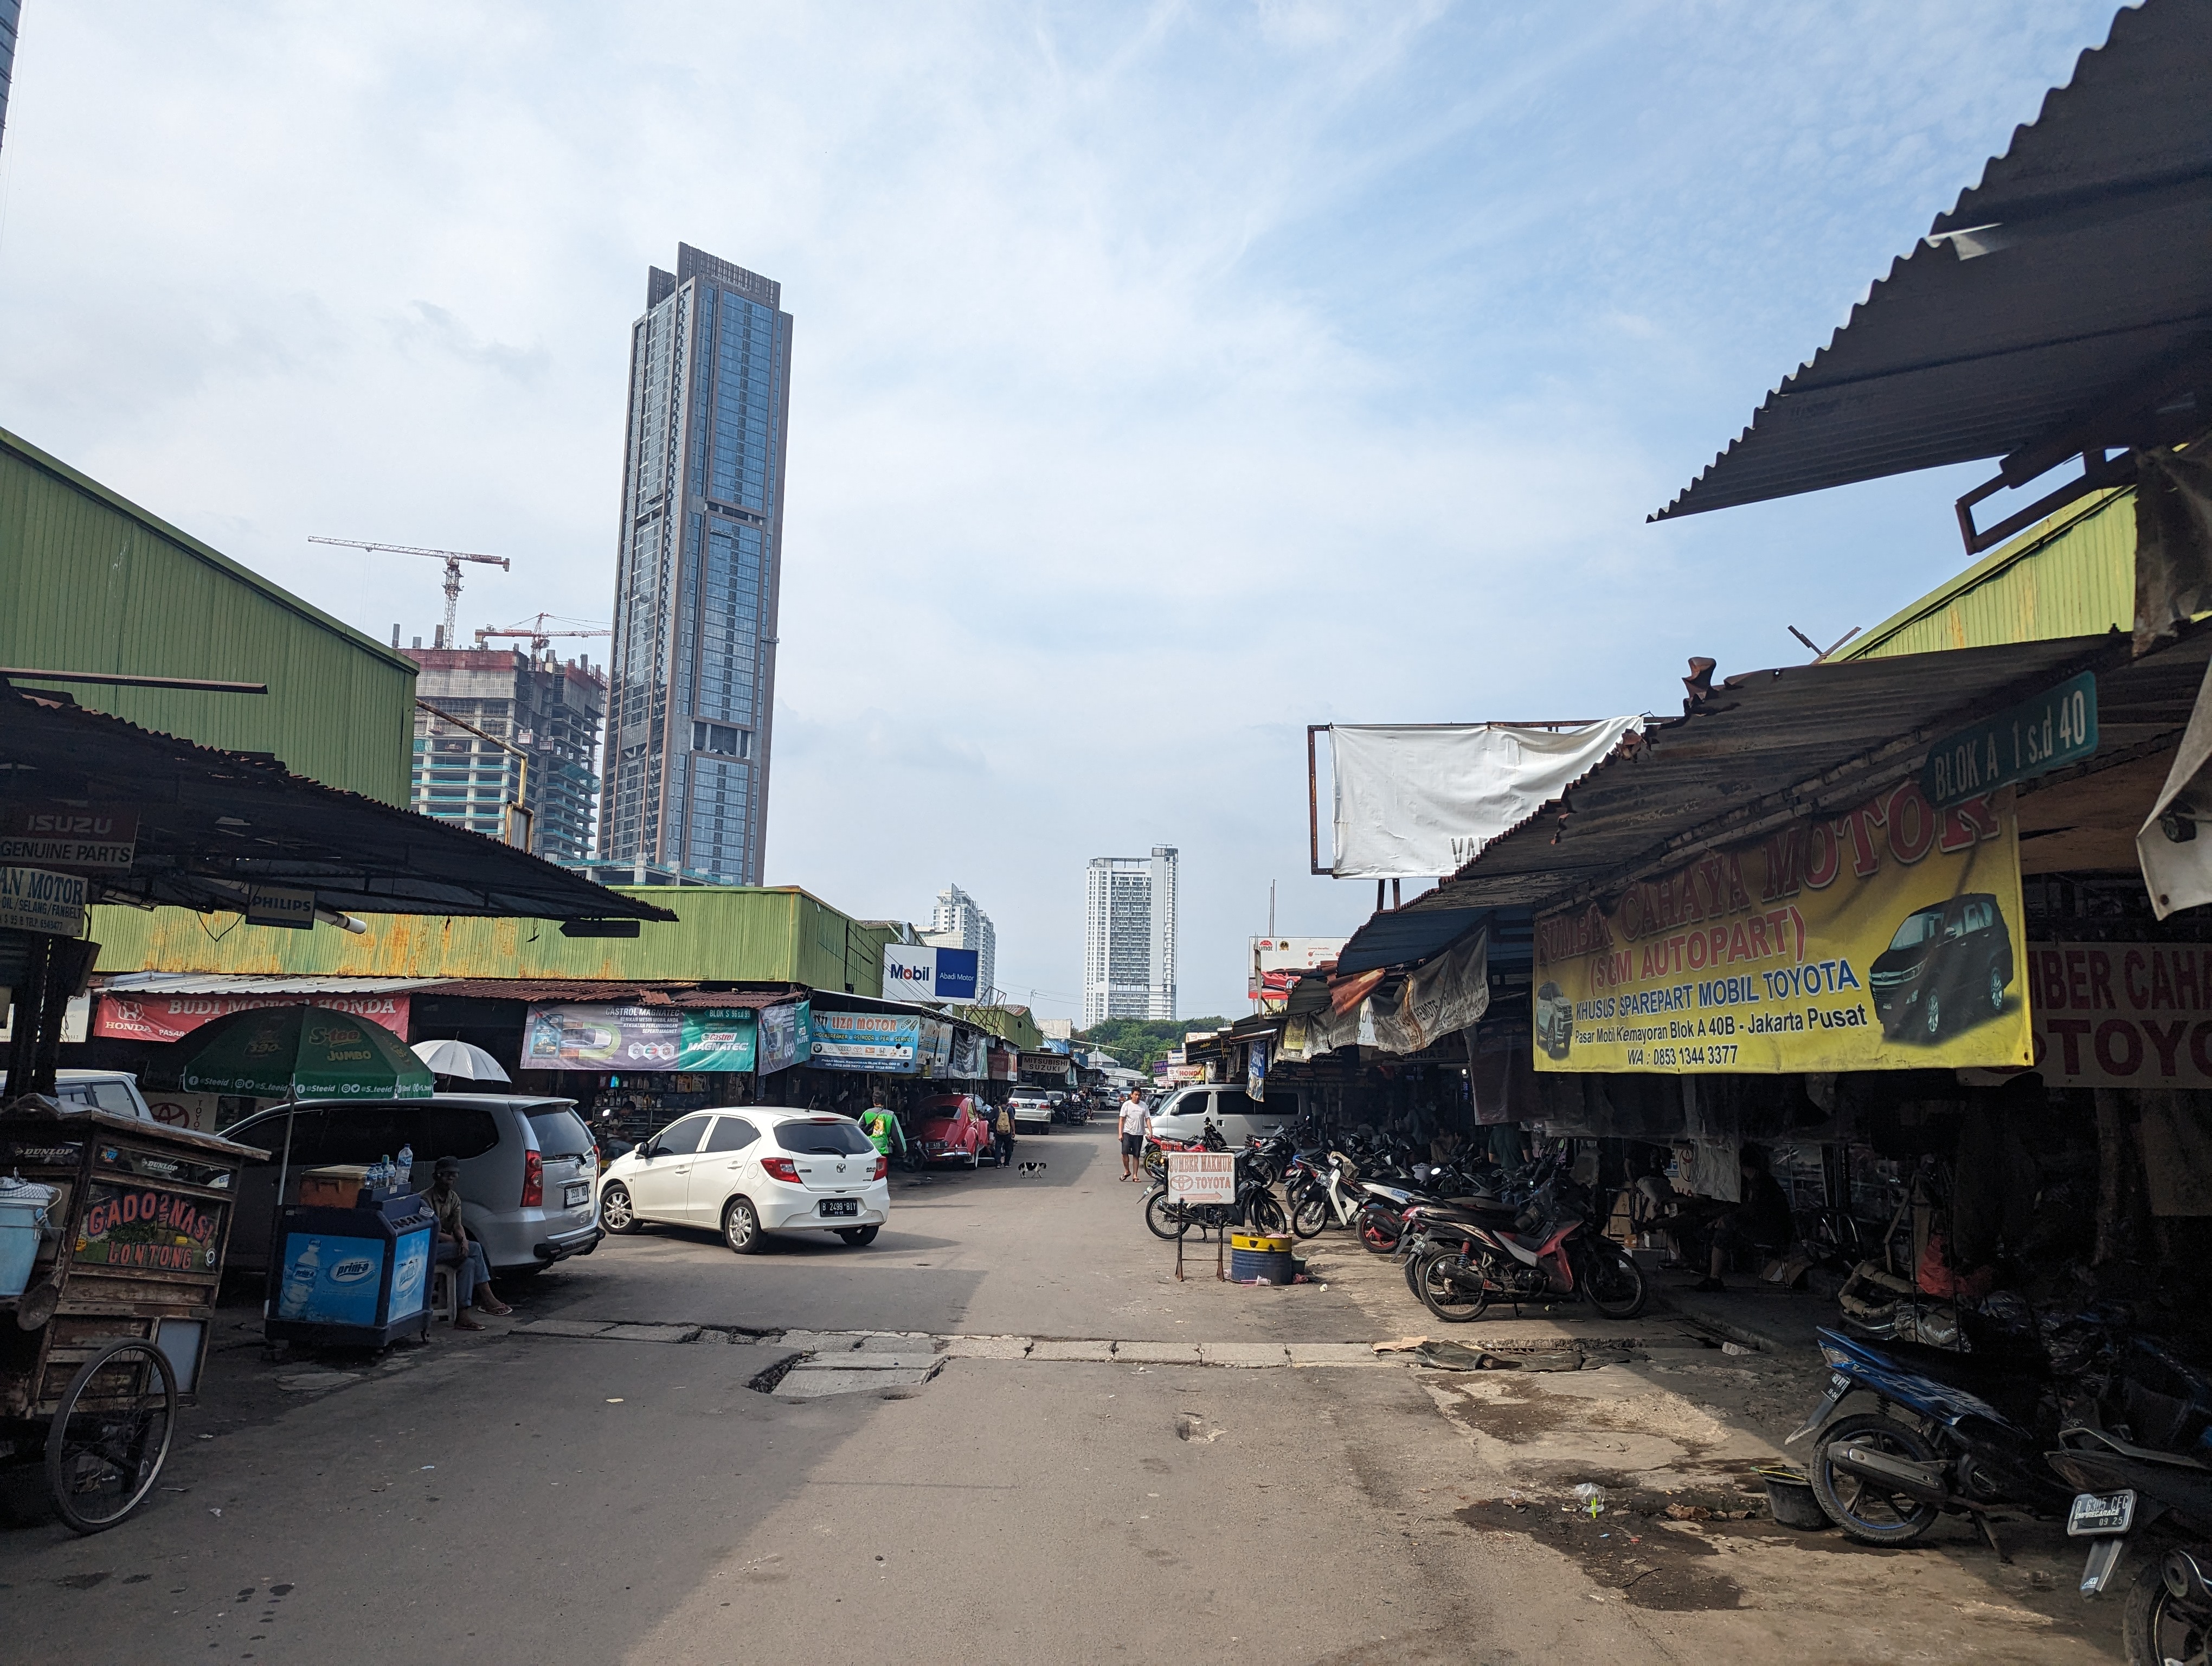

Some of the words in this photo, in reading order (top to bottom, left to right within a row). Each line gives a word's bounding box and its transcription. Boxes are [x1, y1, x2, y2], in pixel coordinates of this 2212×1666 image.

[1934, 739, 1980, 803] BLOK
[1986, 732, 1999, 781] A
[2012, 721, 2020, 768] 1
[2060, 690, 2086, 749] 40
[28, 815, 113, 834] ISUZU
[1, 841, 73, 860] GENUINE
[76, 844, 131, 862] PARTS
[1538, 901, 1615, 966] SUMBER
[1620, 851, 1751, 941] CAHAYA
[1761, 780, 2001, 904] MOTOR
[28, 872, 83, 906] MOTOR
[251, 895, 311, 912] PHILIPS
[1590, 948, 1633, 997] (SCM
[1639, 904, 1806, 982] AUTOPART)
[890, 963, 930, 981] Mobil
[957, 973, 975, 982] Motor
[1576, 996, 1616, 1023] KHUSUS
[1619, 984, 1693, 1017] SPAREPART
[1699, 974, 1760, 1008] MOBIL
[1763, 958, 1861, 1001] TOYOTA
[168, 999, 221, 1015] BUDI
[606, 1008, 639, 1016] CASTROL
[639, 1008, 680, 1016] MAGNATEC
[709, 1009, 724, 1017] BLOK
[744, 1010, 750, 1018] 99
[1413, 999, 1439, 1023] REMOTE
[105, 1021, 153, 1033] HONDA
[831, 1016, 853, 1030] LIZA
[856, 1017, 897, 1031] MOTOR
[1574, 1028, 1595, 1044] Pasar
[1596, 1027, 1616, 1043] Mobil
[1616, 1022, 1668, 1045] Kemayoran
[1670, 1020, 1694, 1039] Blok
[1697, 1021, 1707, 1036] A
[1708, 1016, 1735, 1036] 40B
[1747, 1004, 1804, 1034] Jakarta
[1808, 1002, 1868, 1030] Pusat
[158, 1029, 185, 1037] PASAR
[687, 1042, 749, 1051] MAGNATEC
[326, 1050, 372, 1061] JUMBO
[1024, 1057, 1069, 1066] MITSUBISHI
[1628, 1049, 1645, 1066] WA
[1654, 1047, 1676, 1066] 0853
[1679, 1046, 1705, 1065] 1344
[1707, 1045, 1738, 1065] 3377
[1029, 1063, 1060, 1072] SUZUKI
[24, 1148, 74, 1156] DUNLOP
[147, 1161, 178, 1171] DUNLOP
[1169, 1155, 1199, 1172] SUMBER
[1200, 1155, 1232, 1172] MAKMUR
[1195, 1176, 1231, 1189] TOYOTA
[822, 1202, 826, 1211] B
[829, 1202, 843, 1211] 2499
[846, 1202, 856, 1211] BIY
[88, 1193, 157, 1236] GADO
[168, 1199, 214, 1247] NASI
[108, 1240, 192, 1270] LONTONG
[2086, 1497, 2106, 1512] 6305
[2111, 1495, 2129, 1510] CEG
[2098, 1518, 2108, 1526] 09
[2112, 1517, 2123, 1526] 25
